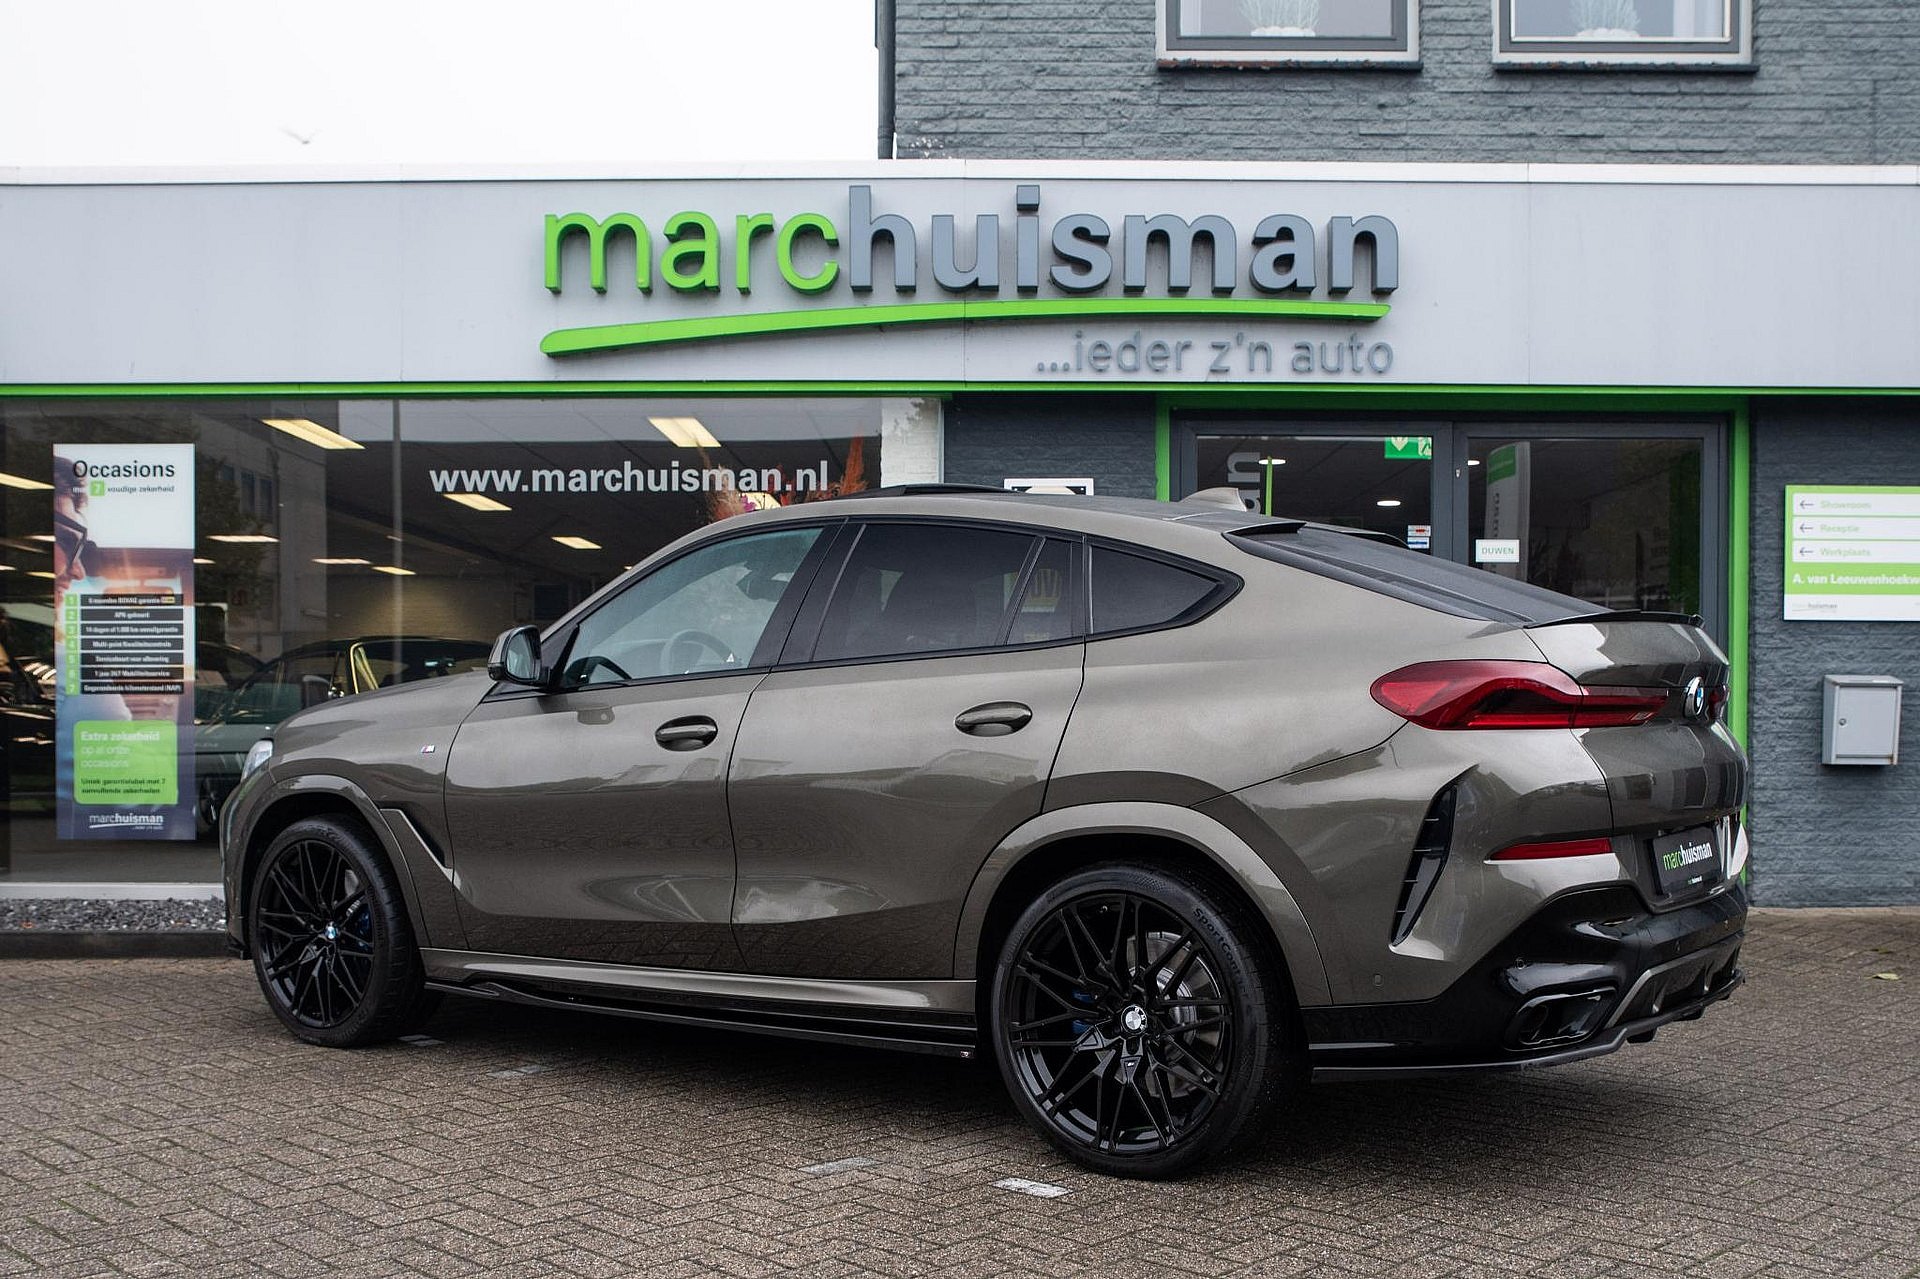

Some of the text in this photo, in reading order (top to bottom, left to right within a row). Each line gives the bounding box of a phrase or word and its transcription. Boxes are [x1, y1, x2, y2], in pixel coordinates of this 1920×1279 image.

[544, 185, 1398, 295] marchuisman
[1037, 331, 1394, 373] ...ieder z'n auto
[73, 460, 175, 478] Occasions
[429, 460, 828, 493] www.marchuisman.nl
[1481, 547, 1515, 555] DUWEN
[1792, 573, 1805, 584] A.
[1807, 575, 1828, 584] van
[81, 731, 160, 741] Extra zekerheid
[89, 813, 163, 824] marchuisman
[1663, 842, 1713, 871] marchuisman
